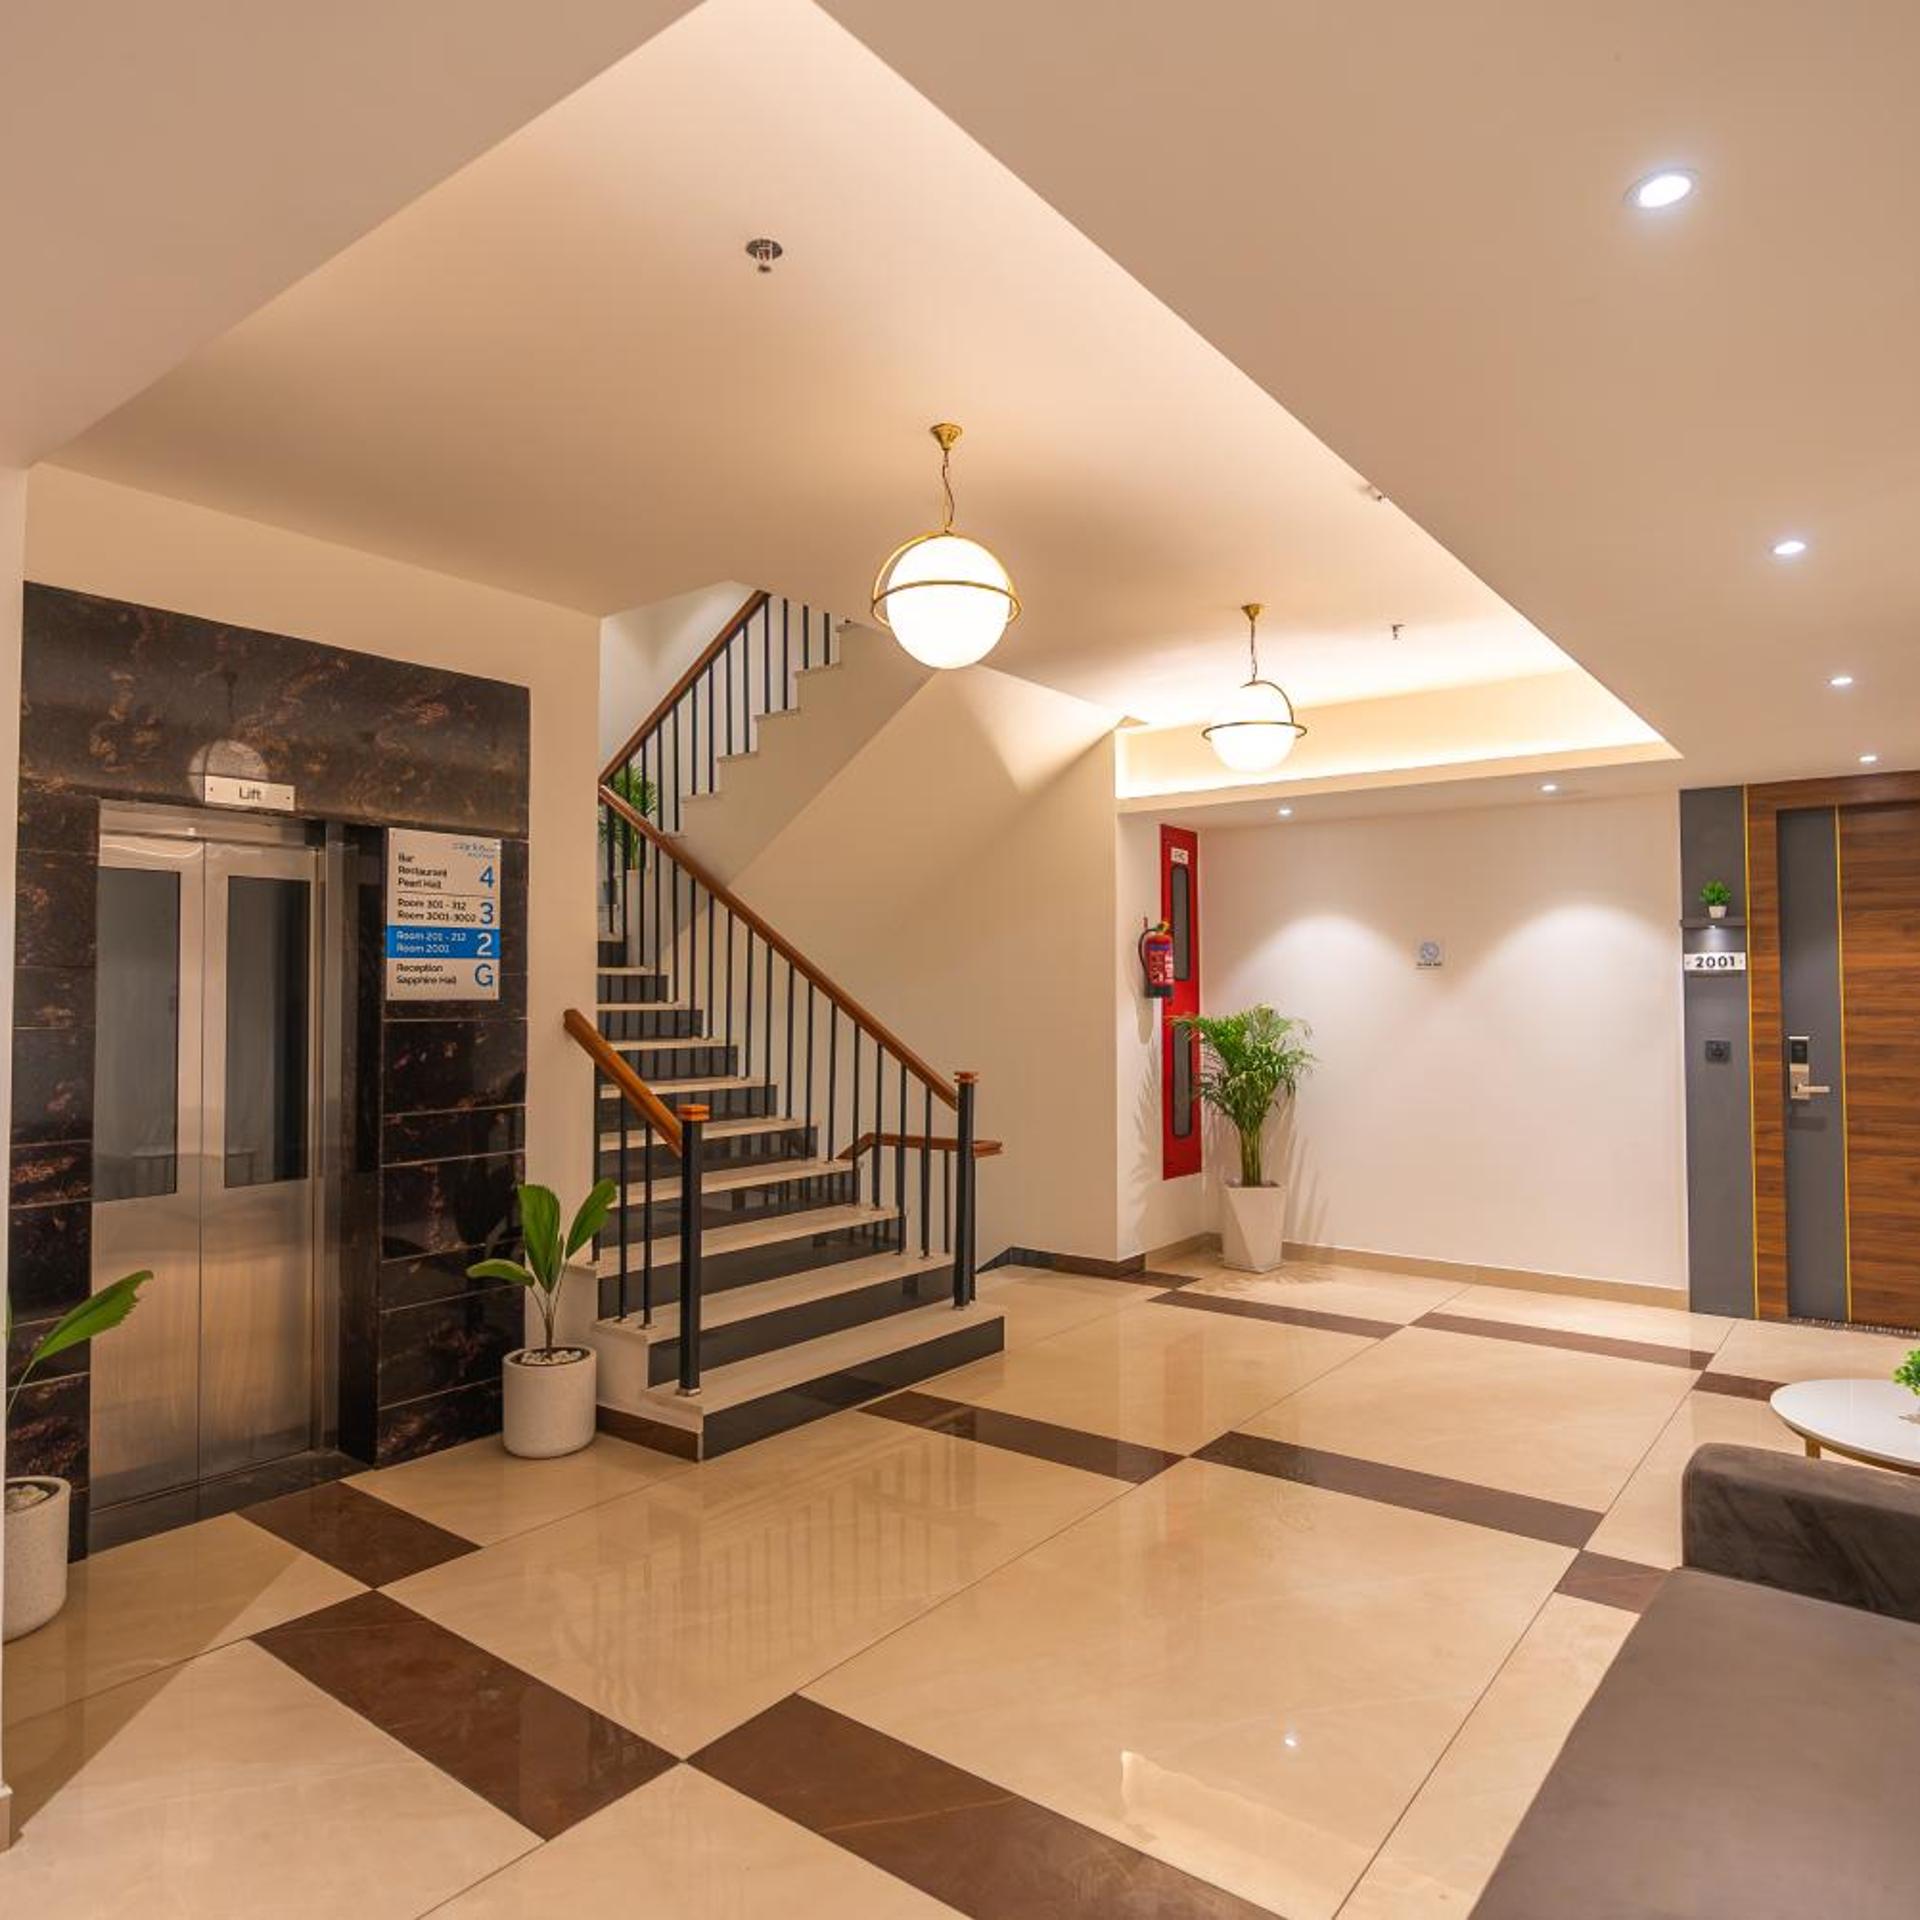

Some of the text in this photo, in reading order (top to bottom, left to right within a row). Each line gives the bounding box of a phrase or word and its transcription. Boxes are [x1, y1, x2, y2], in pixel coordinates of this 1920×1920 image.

[239, 785, 262, 800] Lift
[398, 865, 447, 877] Restaurant
[479, 865, 495, 889] 4
[398, 877, 442, 890] Pearl Hall
[398, 898, 424, 908] Room
[398, 910, 424, 920] Room
[479, 902, 494, 925] 3
[396, 930, 424, 941] Room
[396, 943, 424, 953] Room
[476, 932, 493, 957] 2
[1695, 955, 1735, 968] 2001
[396, 963, 443, 974] Reception
[396, 974, 457, 986] Sapphire Hall
[475, 964, 494, 987] G
